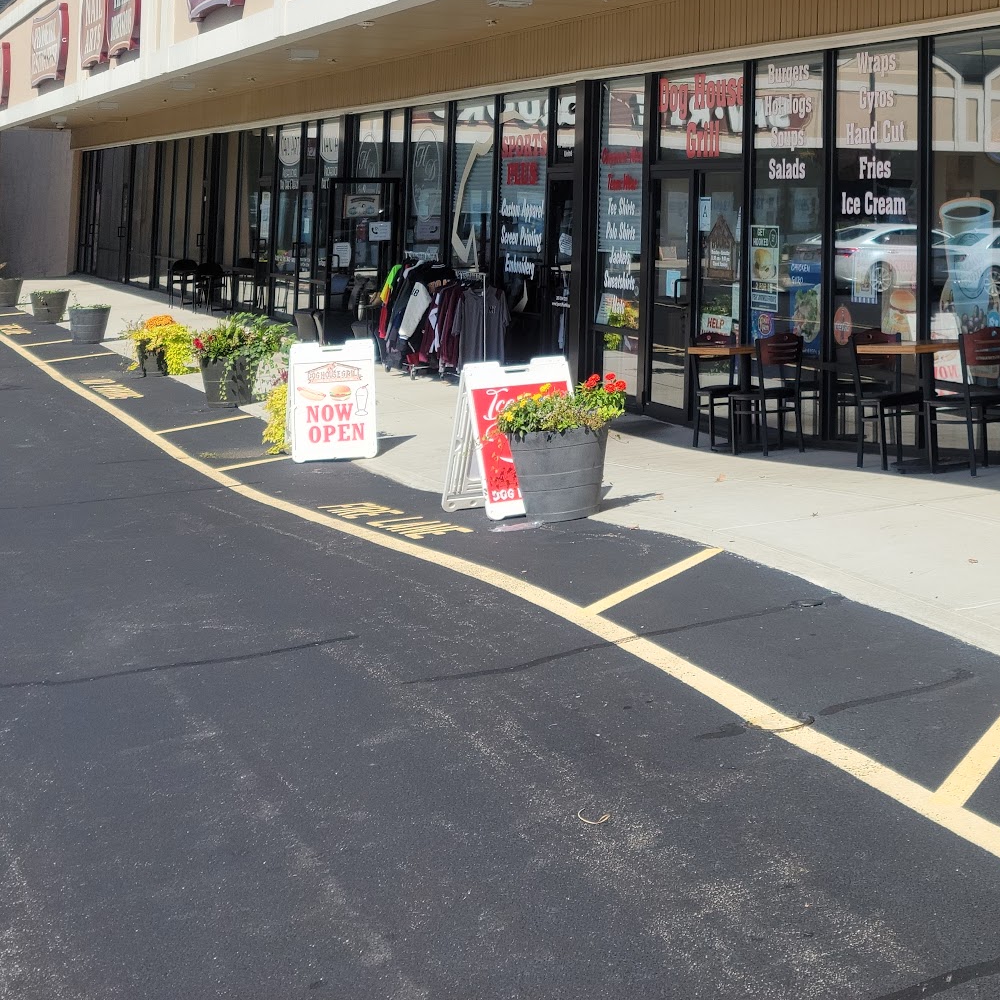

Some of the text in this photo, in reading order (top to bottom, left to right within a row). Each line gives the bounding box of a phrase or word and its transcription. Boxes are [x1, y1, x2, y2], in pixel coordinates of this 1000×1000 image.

[767, 63, 810, 87] Burgers
[856, 51, 897, 77] Wraps
[658, 77, 688, 120] Dog
[694, 72, 743, 110] House
[859, 86, 894, 113] Gyros
[686, 120, 720, 159] Grill
[771, 126, 805, 151] Soups
[845, 119, 905, 145] Hand Cut
[501, 133, 547, 158] SPORTS
[506, 162, 538, 185] PLUS
[768, 158, 806, 180] Salads
[858, 156, 892, 179] Fries
[521, 199, 544, 224] Apparel
[607, 197, 635, 216] Tee Shirts
[841, 191, 907, 215] Ice Cream
[501, 225, 542, 252] Screen Printing
[619, 222, 635, 241] Shirts
[603, 270, 636, 291] Sweatshirts
[707, 317, 725, 329] HELP
[306, 403, 353, 423] NOW
[308, 423, 365, 443] OPEN
